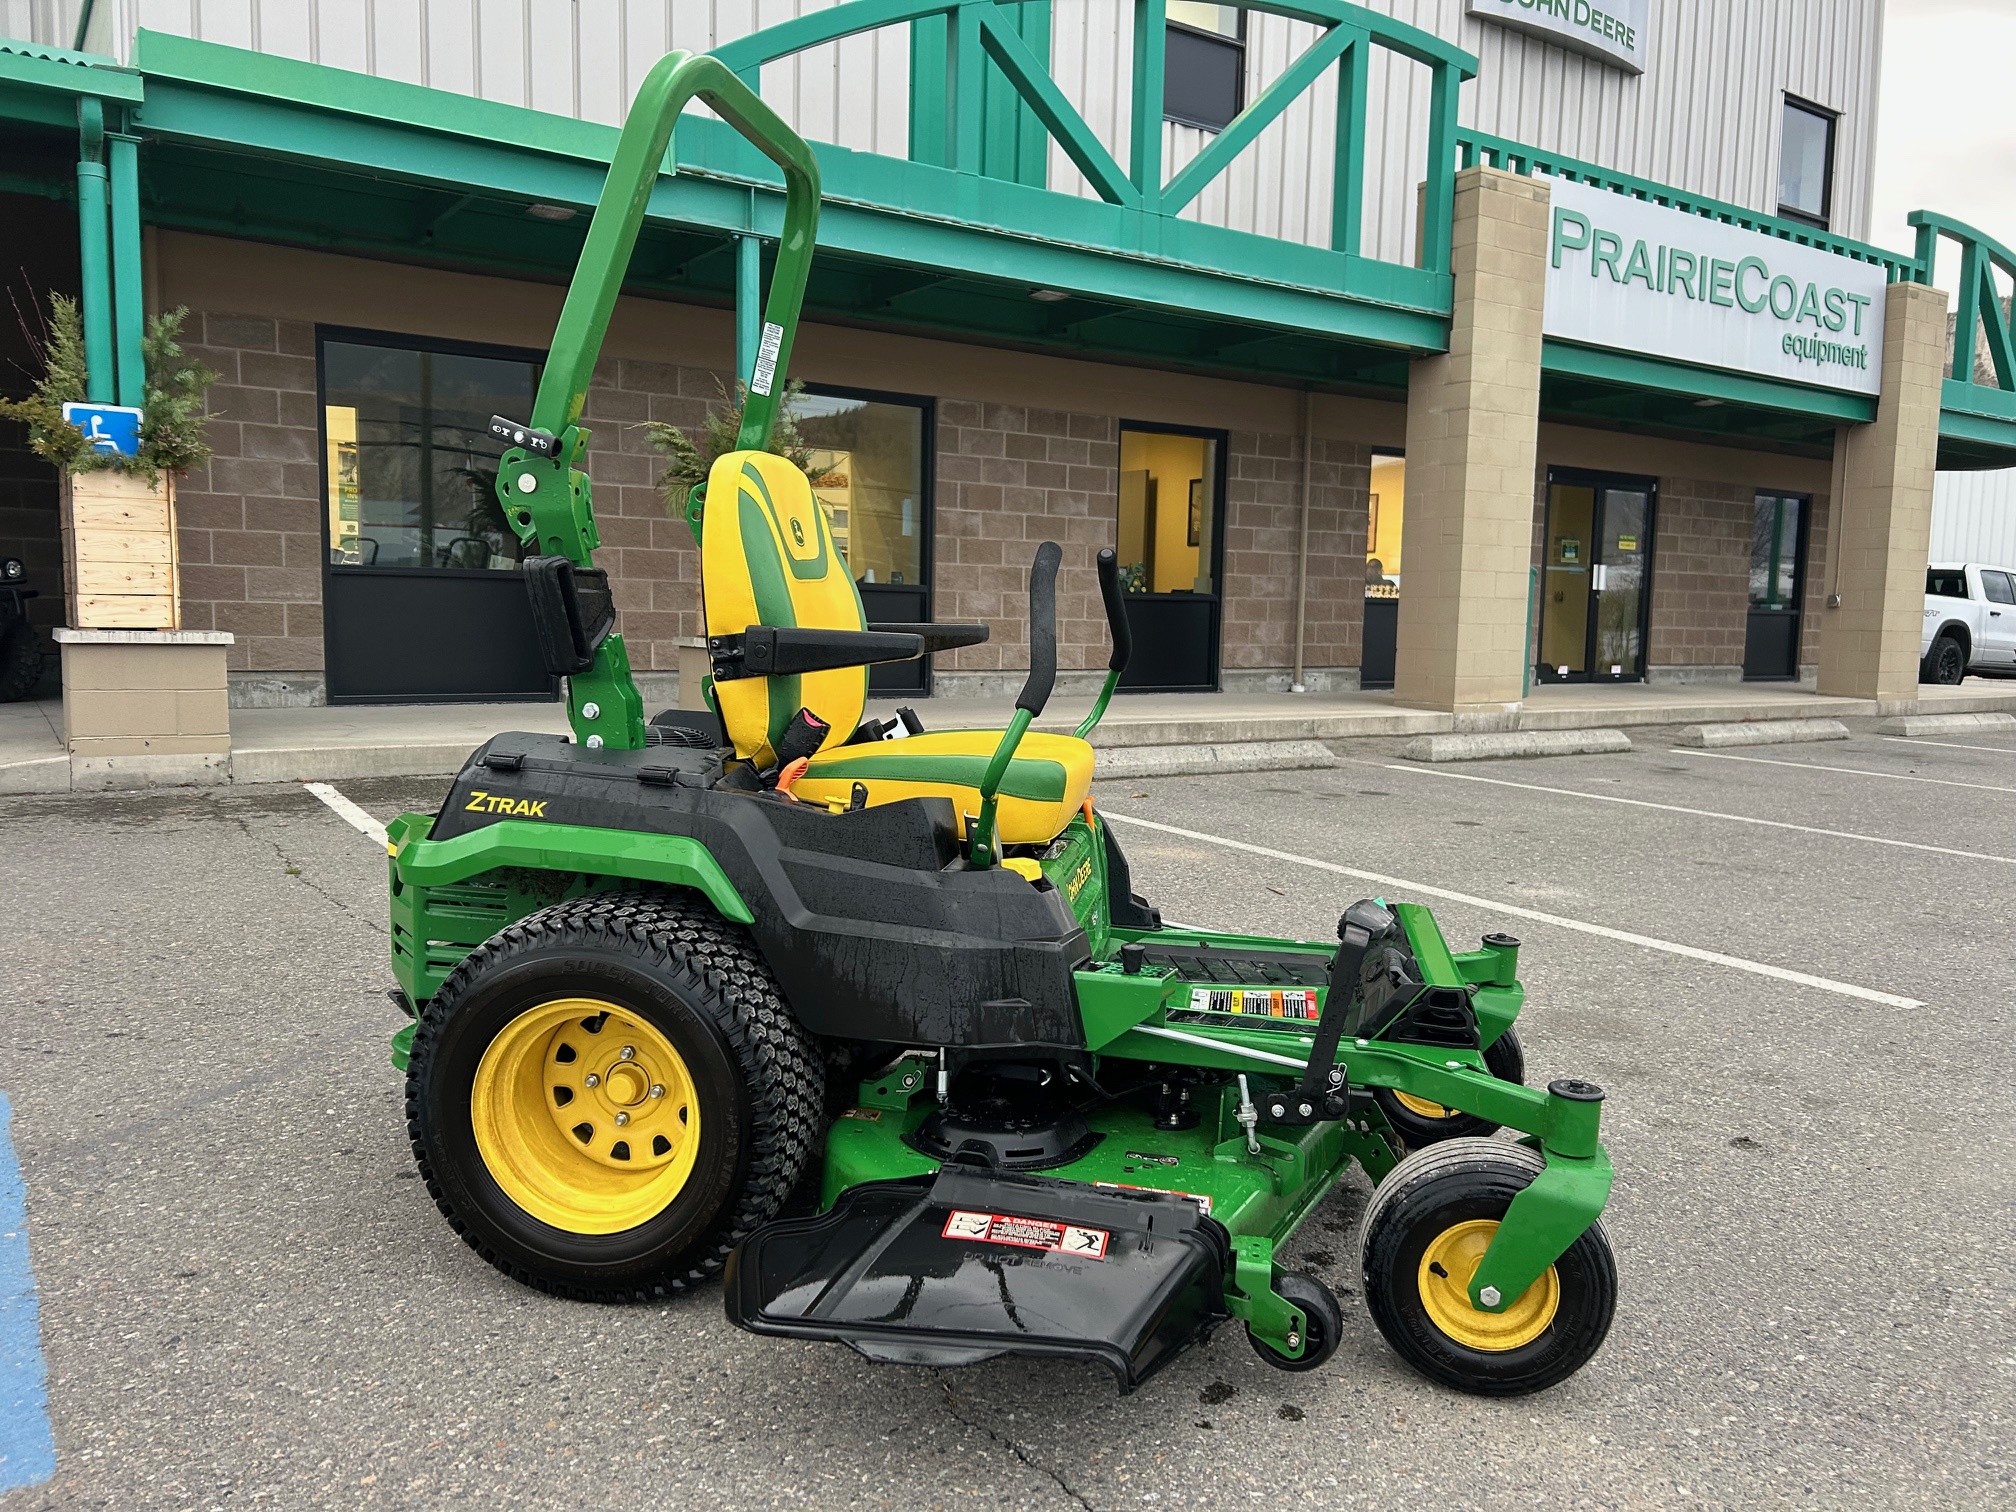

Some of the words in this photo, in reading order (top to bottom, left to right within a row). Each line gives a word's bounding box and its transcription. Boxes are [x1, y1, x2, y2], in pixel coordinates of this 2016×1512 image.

[1503, 0, 1570, 21] HN
[1573, 0, 1636, 51] DEERE
[1782, 331, 1868, 369] equipment
[464, 791, 548, 818] ZTRAK
[562, 959, 636, 985] SUPER
[1012, 1217, 1058, 1230] DANGER
[963, 1251, 985, 1262] DO
[1023, 1257, 1083, 1276] REMOVE
